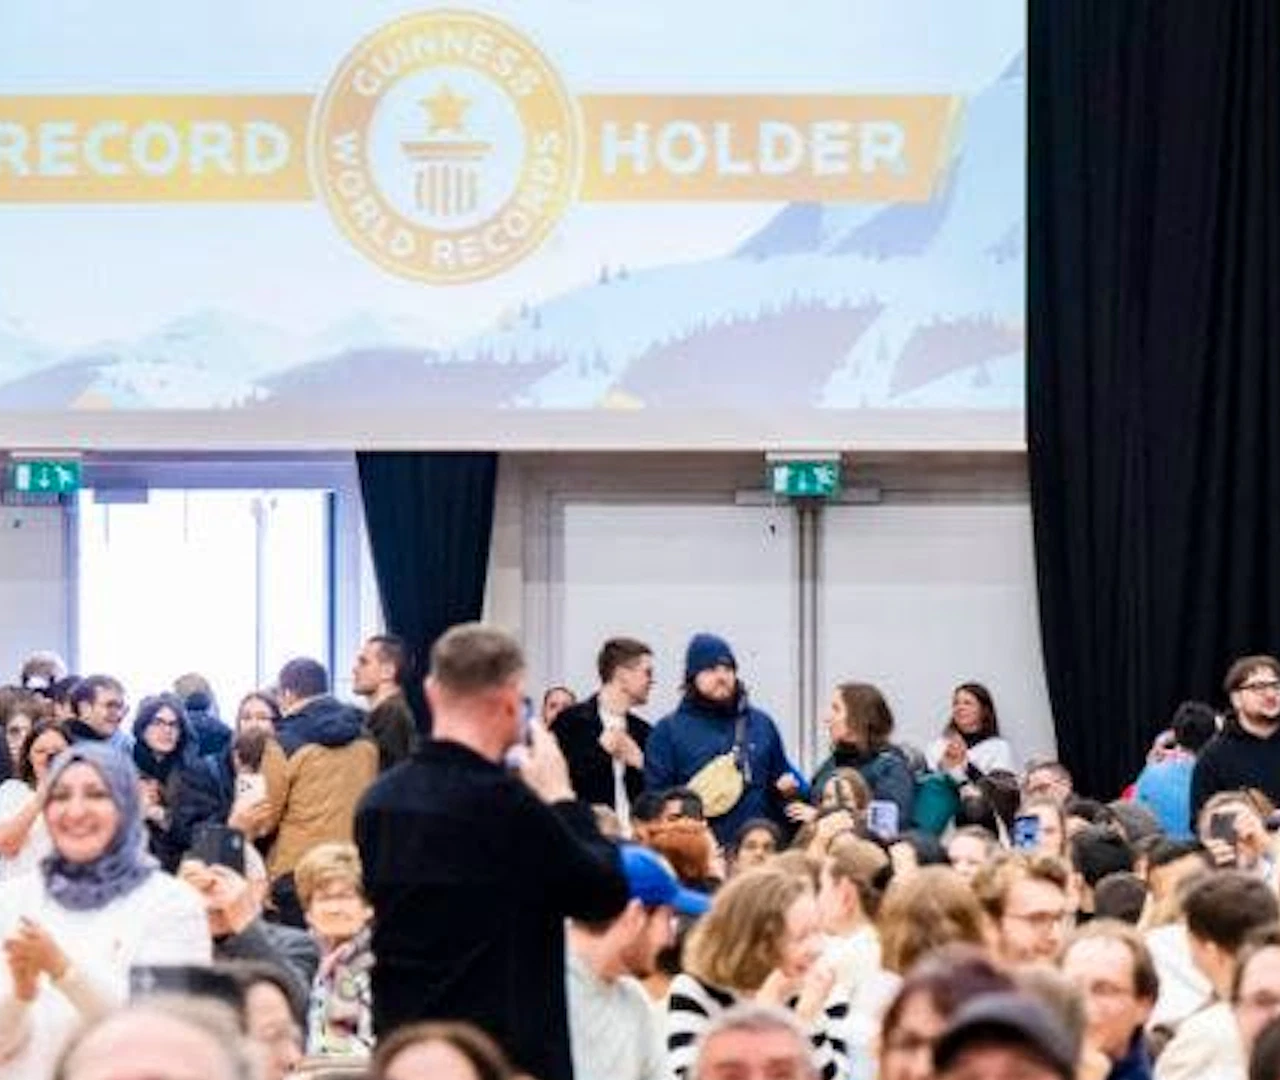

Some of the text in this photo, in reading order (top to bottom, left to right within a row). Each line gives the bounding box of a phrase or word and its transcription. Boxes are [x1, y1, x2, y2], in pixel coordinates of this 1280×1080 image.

[352, 33, 539, 96] GUINNESS
[600, 119, 910, 176] HOLDER
[332, 131, 558, 269] WORLD RECORDS
